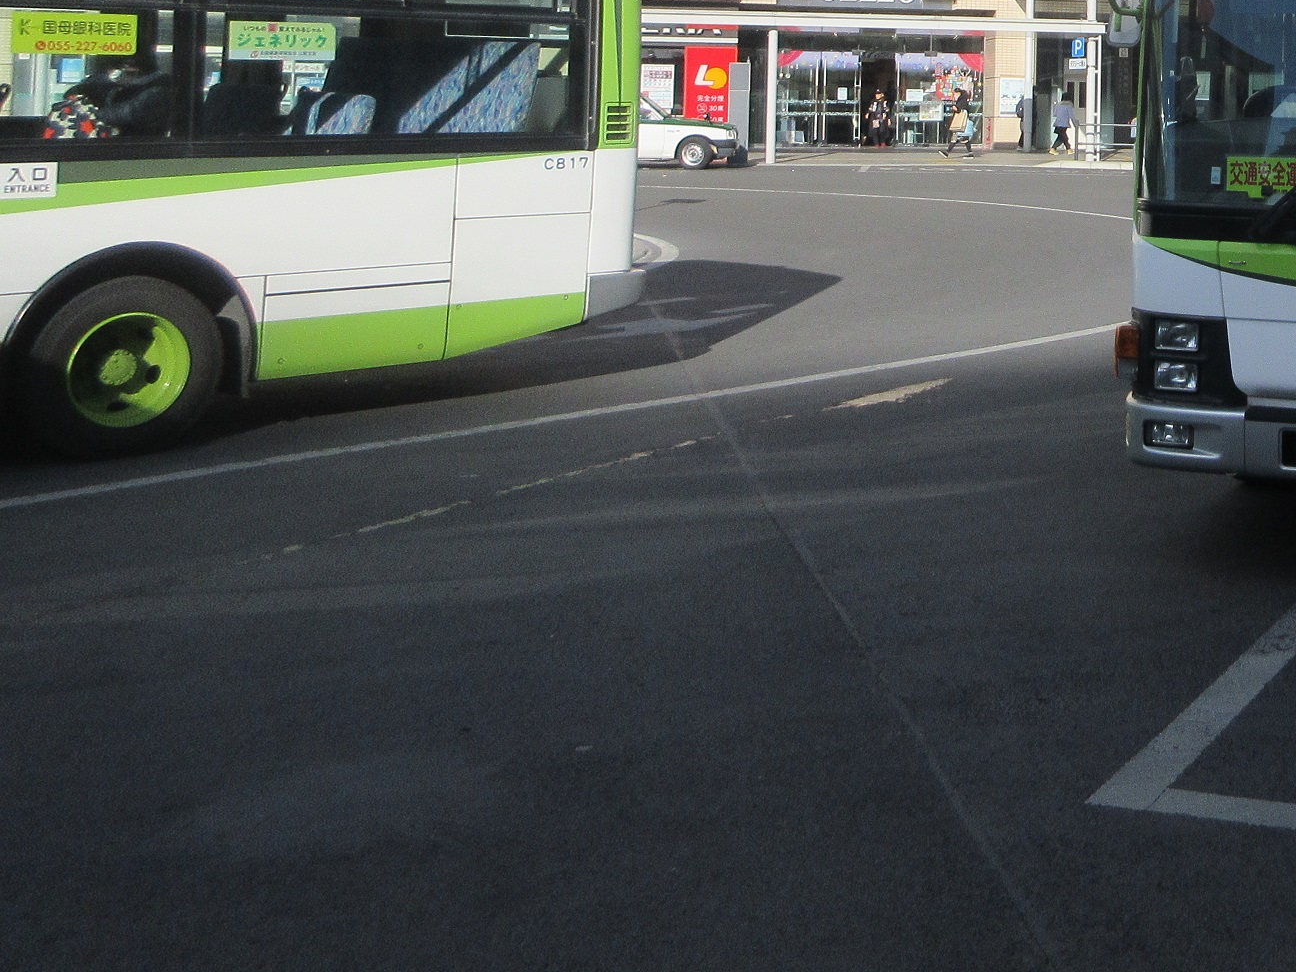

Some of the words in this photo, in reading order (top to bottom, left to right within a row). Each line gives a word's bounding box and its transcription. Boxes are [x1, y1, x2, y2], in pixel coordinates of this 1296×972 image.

[42, 19, 132, 37] 国母眼科医院
[47, 40, 133, 52] 055-227-6060
[236, 32, 328, 48] ジェネリック
[544, 156, 589, 170] C817
[7, 167, 48, 183] 入口
[4, 184, 52, 194] ENTRANCE
